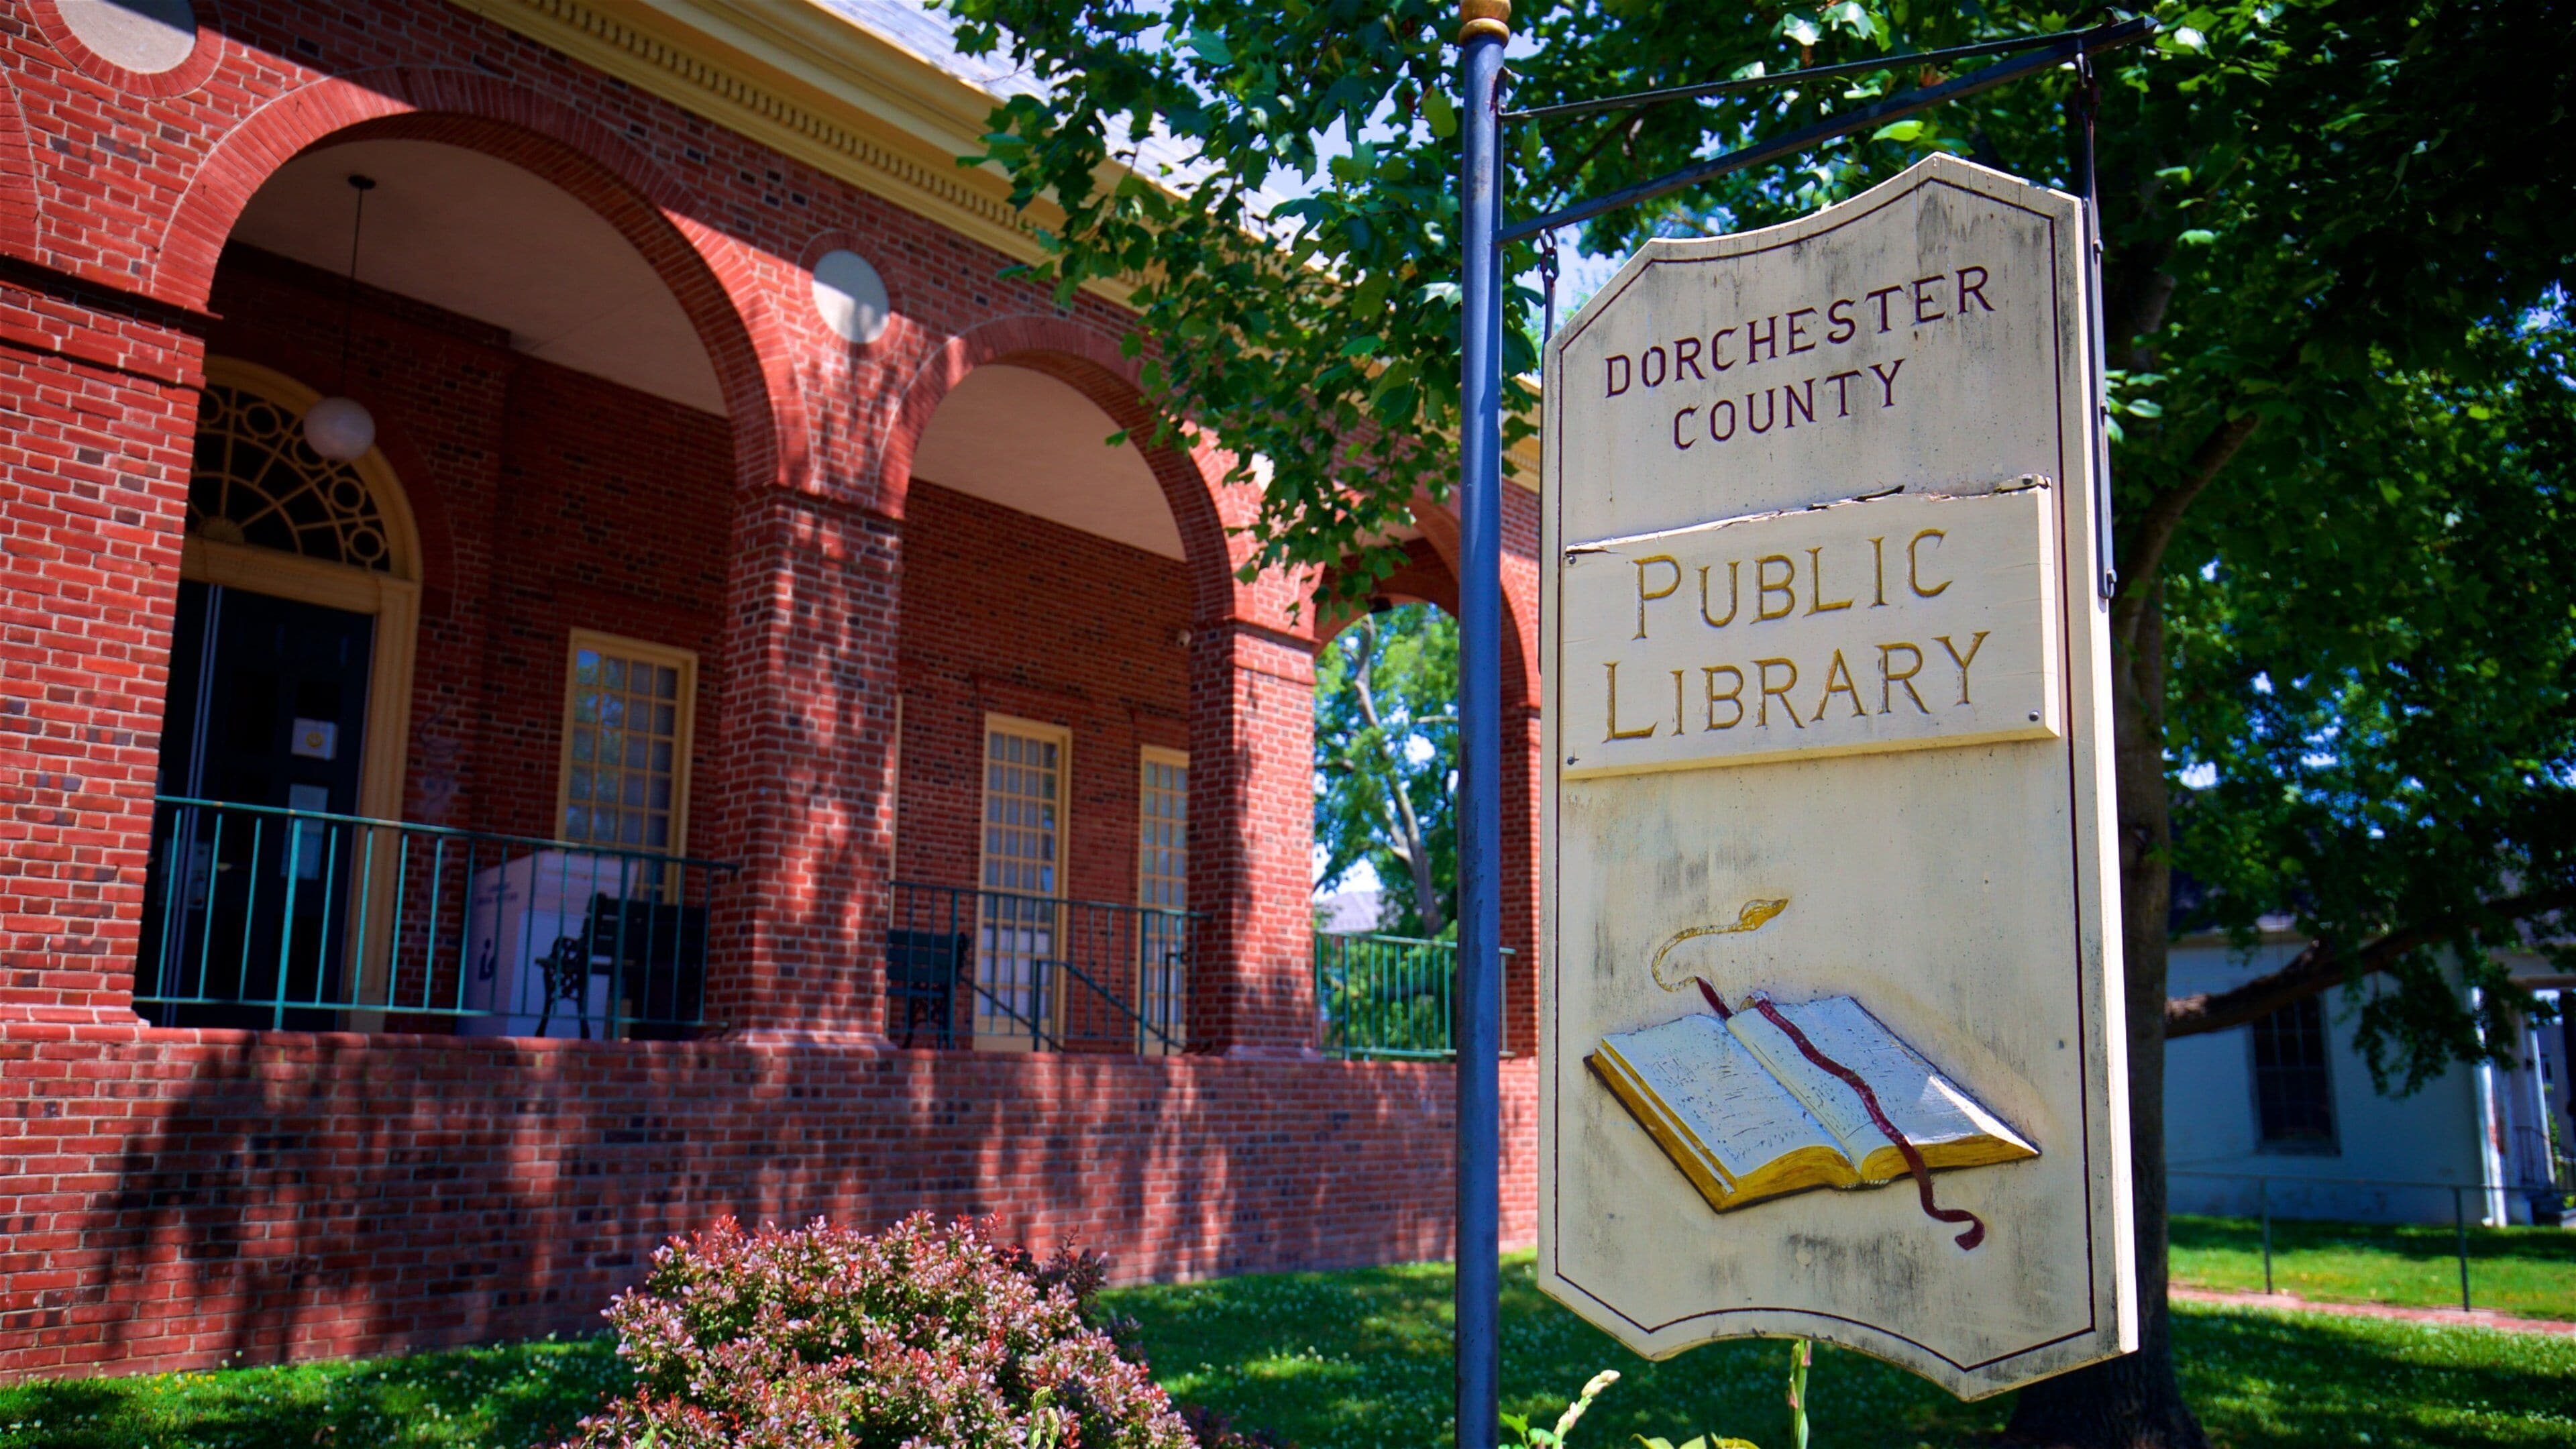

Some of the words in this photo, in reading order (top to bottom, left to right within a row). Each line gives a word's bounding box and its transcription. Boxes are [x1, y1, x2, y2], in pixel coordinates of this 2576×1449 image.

[1605, 266, 1996, 399] DORCHESTER
[1673, 358, 1906, 451] COUNTY
[1631, 528, 1953, 641] PUBLIC
[1601, 631, 1990, 743] LIBRARY
